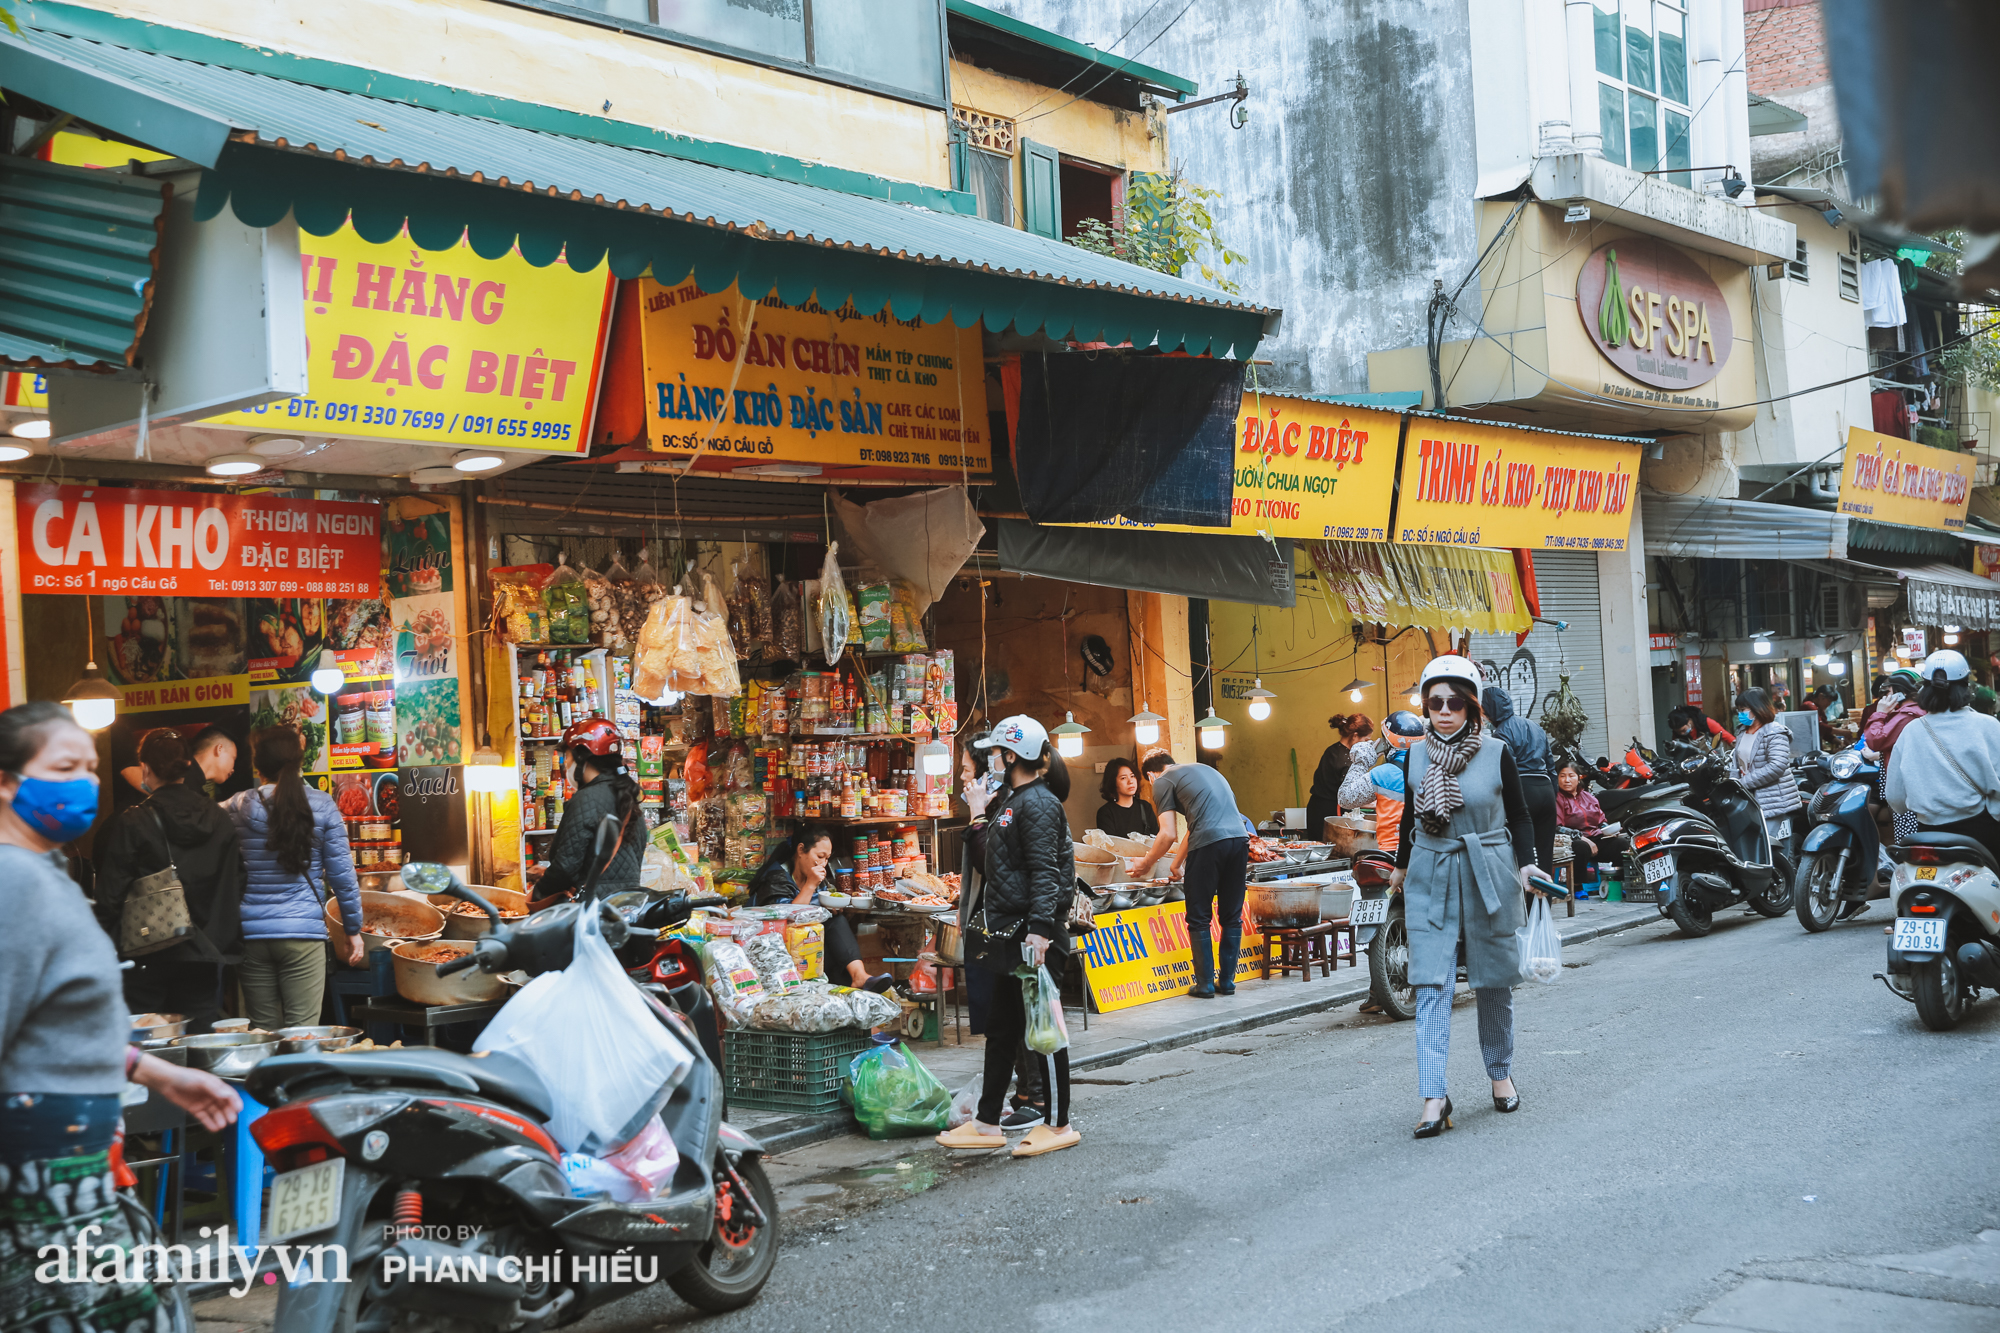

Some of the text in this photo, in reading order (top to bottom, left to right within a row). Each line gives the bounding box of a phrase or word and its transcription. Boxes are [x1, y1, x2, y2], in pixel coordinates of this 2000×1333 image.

[351, 247, 507, 325] HẰNG
[648, 291, 676, 313] LIÊN
[1628, 284, 1718, 366] SF SPA
[692, 306, 737, 363] ĐỒ
[792, 332, 860, 378] CHÍN
[865, 343, 953, 371] MẮM TÉP CHƯNG
[331, 331, 450, 397] ĐẶC
[465, 347, 577, 411] BIỆT
[867, 364, 938, 386] THỊT CÁ KHO
[288, 397, 319, 420] ĐT:
[324, 401, 359, 423] 091
[362, 405, 397, 426] 330
[400, 408, 446, 430] 7699
[462, 414, 492, 435] 091
[497, 418, 528, 438] 655
[530, 419, 572, 440] 9995
[656, 373, 883, 440] HÀNG KHÔ ĐẶC SẢN
[886, 402, 962, 424] CAFE CÁC LOẠI
[662, 431, 774, 455] ĐC: SỐ NGÕ CẦU GỖ
[887, 422, 909, 440] CHÈ
[910, 424, 937, 442] THÁI
[1240, 407, 1369, 471] ĐẶC BIỆT
[859, 448, 875, 463] ĐT:
[875, 450, 892, 464] 098
[892, 451, 909, 465] 923
[911, 452, 931, 466] 7416
[938, 453, 959, 467] 0913
[976, 456, 988, 469] 111
[1852, 441, 1884, 491] PHỞ
[1881, 449, 1901, 496] GÀ
[1266, 471, 1300, 493] CHUA
[1302, 476, 1338, 497] NGỌT
[1415, 439, 1480, 505] TRINH
[1480, 449, 1501, 506] CÁ
[1502, 463, 1537, 508] KHO
[1540, 465, 1576, 518] THỊT
[1573, 469, 1603, 514] KHO
[1232, 497, 1300, 520] HO TƯƠNG
[32, 489, 230, 571] CÁ KHO
[241, 508, 375, 537] THƠM NGON
[1323, 525, 1384, 540] ĐT: 0962 299 776
[1402, 524, 1481, 545] ĐC: SỐ 5 NGÕ CẦU GỖ
[241, 541, 345, 574] ĐẶC BIỆT
[391, 545, 451, 577] Luôn
[34, 570, 178, 592] ĐC: Số 1 ngõ Cầu Gỗ
[208, 579, 369, 594] Tel: 0913 307 699 088 88 251 88
[398, 648, 450, 679] Tươi
[125, 682, 234, 707] NEM RÁN GIÒN
[403, 767, 460, 804] Sạch
[1646, 866, 1673, 882] 938.11
[1354, 911, 1381, 923] 4881
[1356, 900, 1384, 912] 30-F5
[1082, 913, 1149, 969] HUYỀN
[1147, 908, 1177, 955] CÁ
[1902, 921, 1937, 935] 29-C1
[1896, 935, 1940, 950] 730.94
[1151, 961, 1190, 977] THỊT KHO
[1098, 980, 1145, 1004] 096 229 9776
[1147, 980, 1158, 993] CÁ
[1177, 975, 1191, 988] HAI
[281, 1166, 332, 1206] 29-X8
[278, 1197, 328, 1236] 6255
